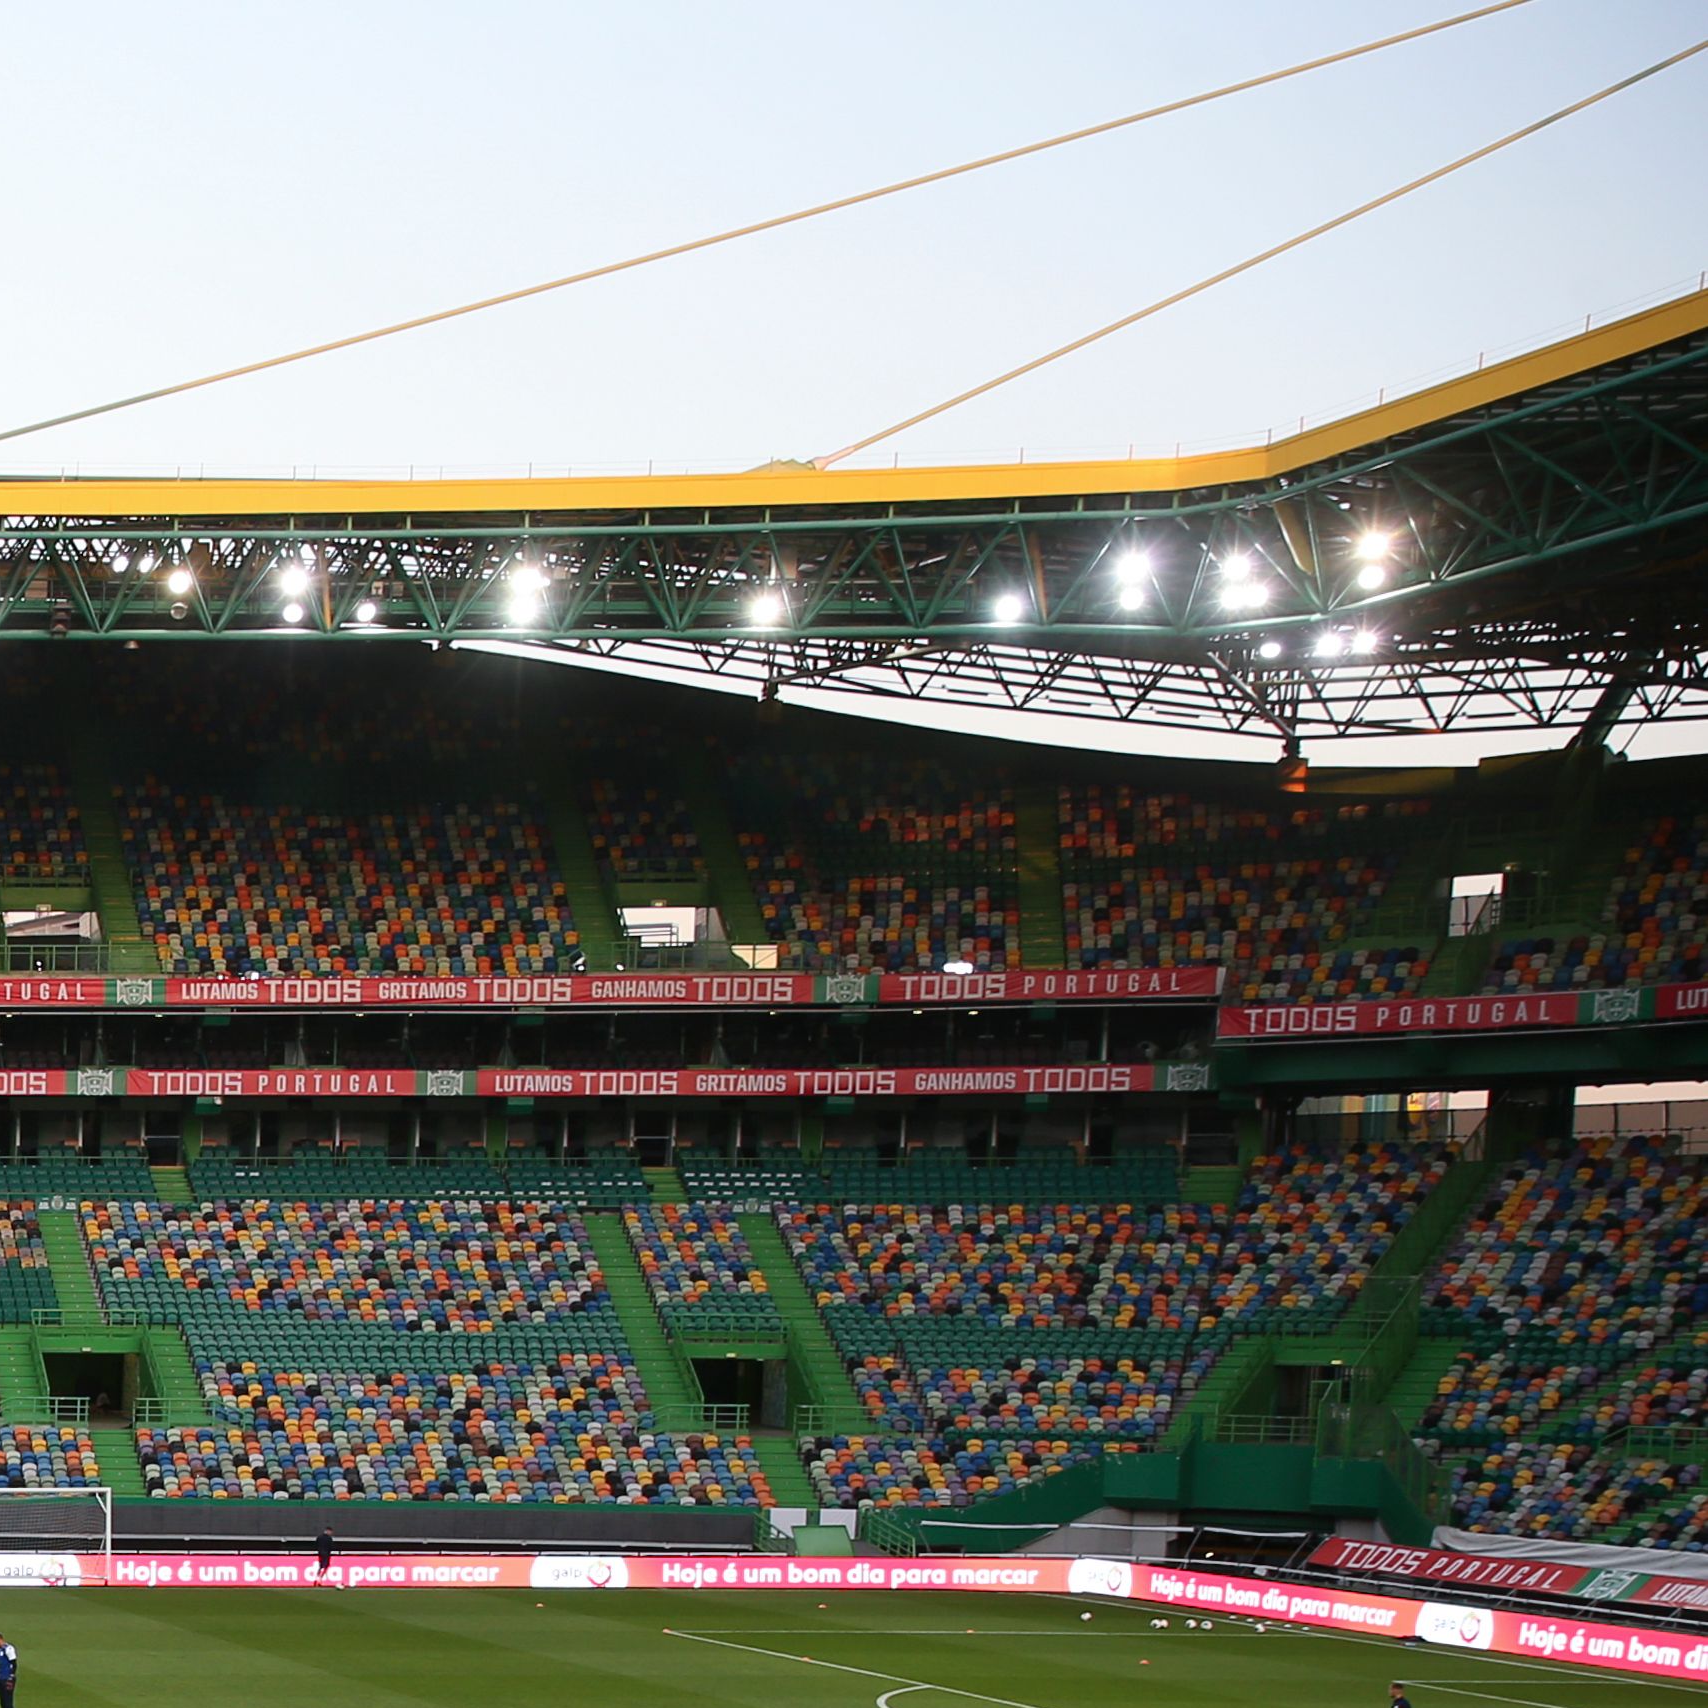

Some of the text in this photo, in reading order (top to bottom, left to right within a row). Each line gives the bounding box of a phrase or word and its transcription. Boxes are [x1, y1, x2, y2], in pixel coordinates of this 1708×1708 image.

[182, 978, 792, 1003] LUTAMOS TODOS GRITAMOS TODOS GANHAMOS TODOS
[900, 972, 1181, 1001] TODOS PORTUGAL
[1244, 1000, 1551, 1033] TODOS PORTUGAL
[148, 1072, 396, 1095] TODOS PORTUGAL
[494, 1068, 1131, 1095] LUTAMOS TODOS GRITAMOS TODOS GANHAMOS TODOS
[117, 1560, 501, 1587] Hoje é um bom para marcar
[663, 1562, 1041, 1589] Hoje é um bom dia para marcar
[1334, 1541, 1563, 1589] TODOS PORTUGAL
[1150, 1574, 1398, 1627] Hoje é um bom dia para marcar
[1518, 1622, 1681, 1667] Hoje é um bom
